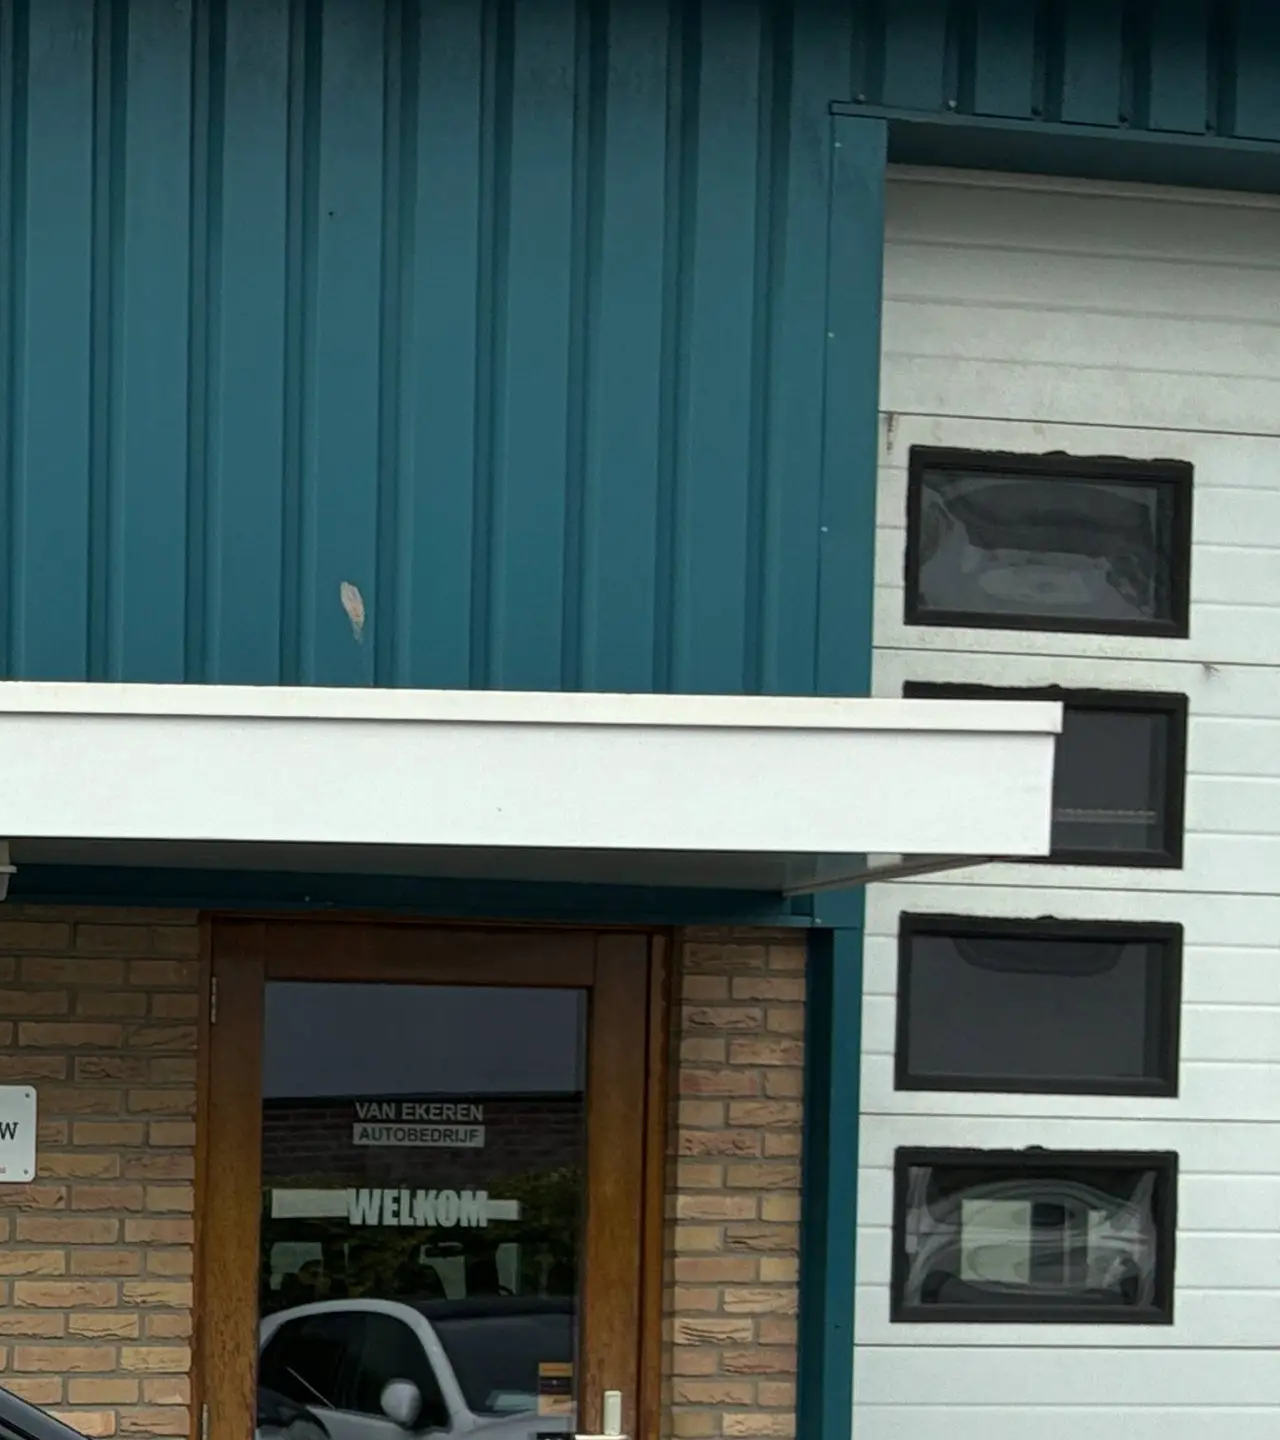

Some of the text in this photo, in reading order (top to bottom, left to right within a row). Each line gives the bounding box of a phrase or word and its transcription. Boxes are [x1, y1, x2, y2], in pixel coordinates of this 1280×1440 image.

[356, 1102, 484, 1121] VAN EKEREN
[359, 1127, 480, 1143] AUTOBEDRIJF
[348, 1187, 489, 1227] WELKOM
